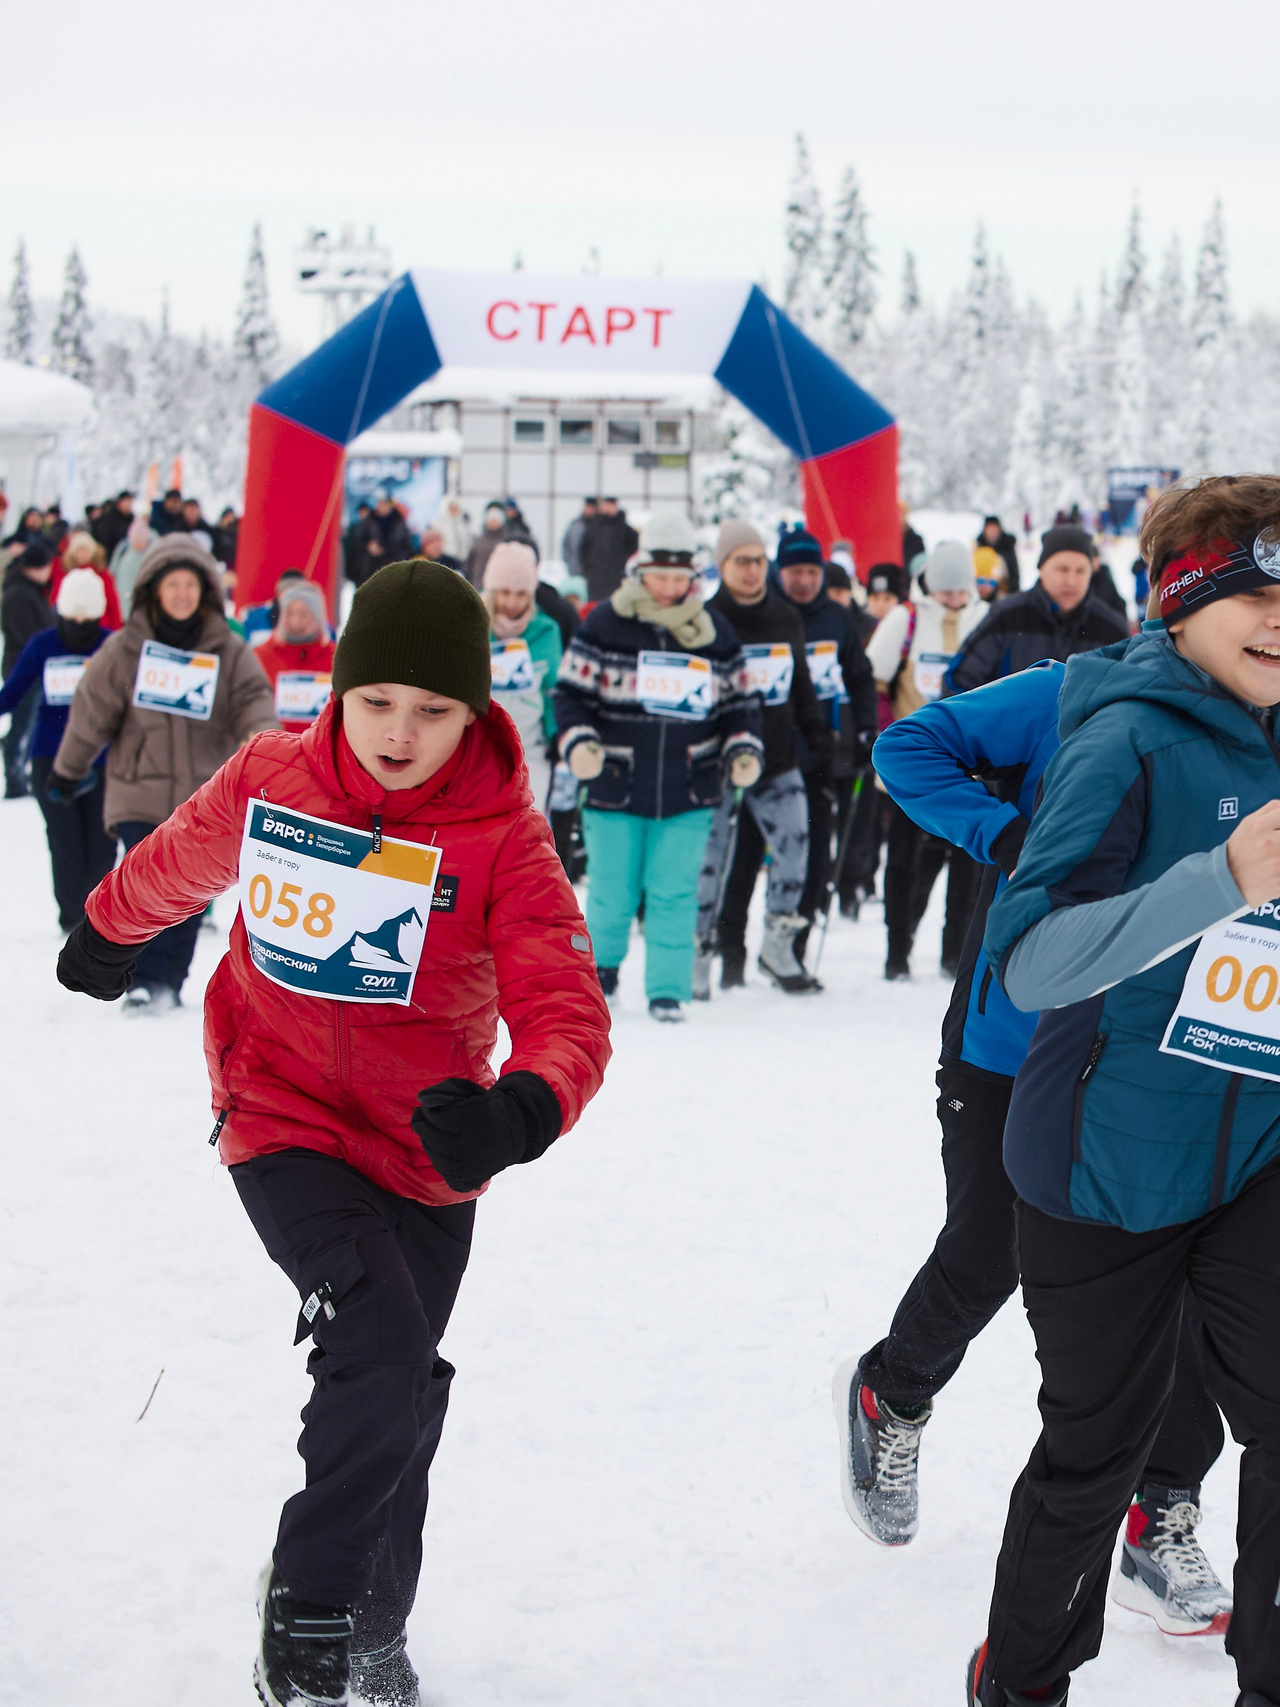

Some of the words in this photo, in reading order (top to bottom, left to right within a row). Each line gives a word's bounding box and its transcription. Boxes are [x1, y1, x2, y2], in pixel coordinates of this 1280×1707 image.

[486, 300, 673, 348] СТАРТ
[145, 669, 180, 691] 021
[315, 841, 351, 856] Гипербореи
[317, 834, 344, 848] Вершина
[256, 849, 278, 862] Забег
[284, 859, 301, 871] гору
[249, 874, 336, 939] 058
[1224, 930, 1249, 942] Забег
[1250, 936, 1257, 944] в
[1257, 938, 1280, 951] гору
[252, 939, 318, 974] КОВДОРСКИЙ
[1183, 1034, 1217, 1052] ГОК
